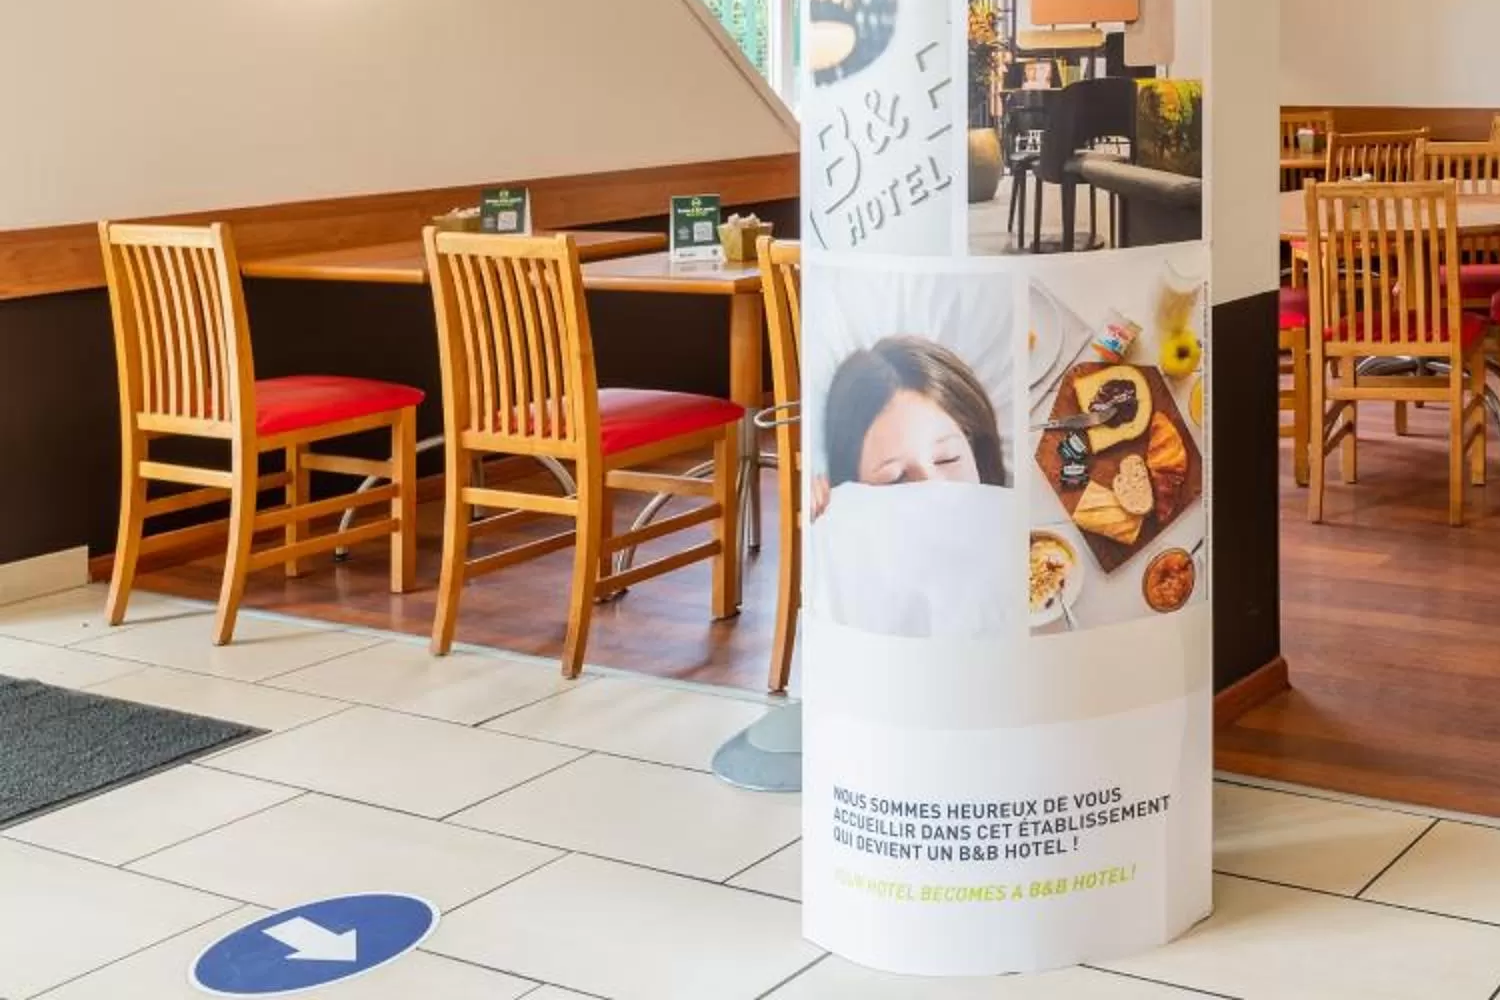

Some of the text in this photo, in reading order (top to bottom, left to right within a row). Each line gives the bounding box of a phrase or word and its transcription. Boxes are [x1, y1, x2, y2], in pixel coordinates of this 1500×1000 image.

[833, 785, 1122, 819] NOUS SOMMES HEUREUX DE VOUS
[833, 794, 1171, 840] ACCUEILLIR DANS CET ÉTABLISSEMENT
[833, 826, 1080, 861] QUI DEVIENT UN B&B HOTEL !
[920, 884, 1007, 902] BECOMES
[1011, 883, 1023, 900] A
[1029, 877, 1069, 898] B&B
